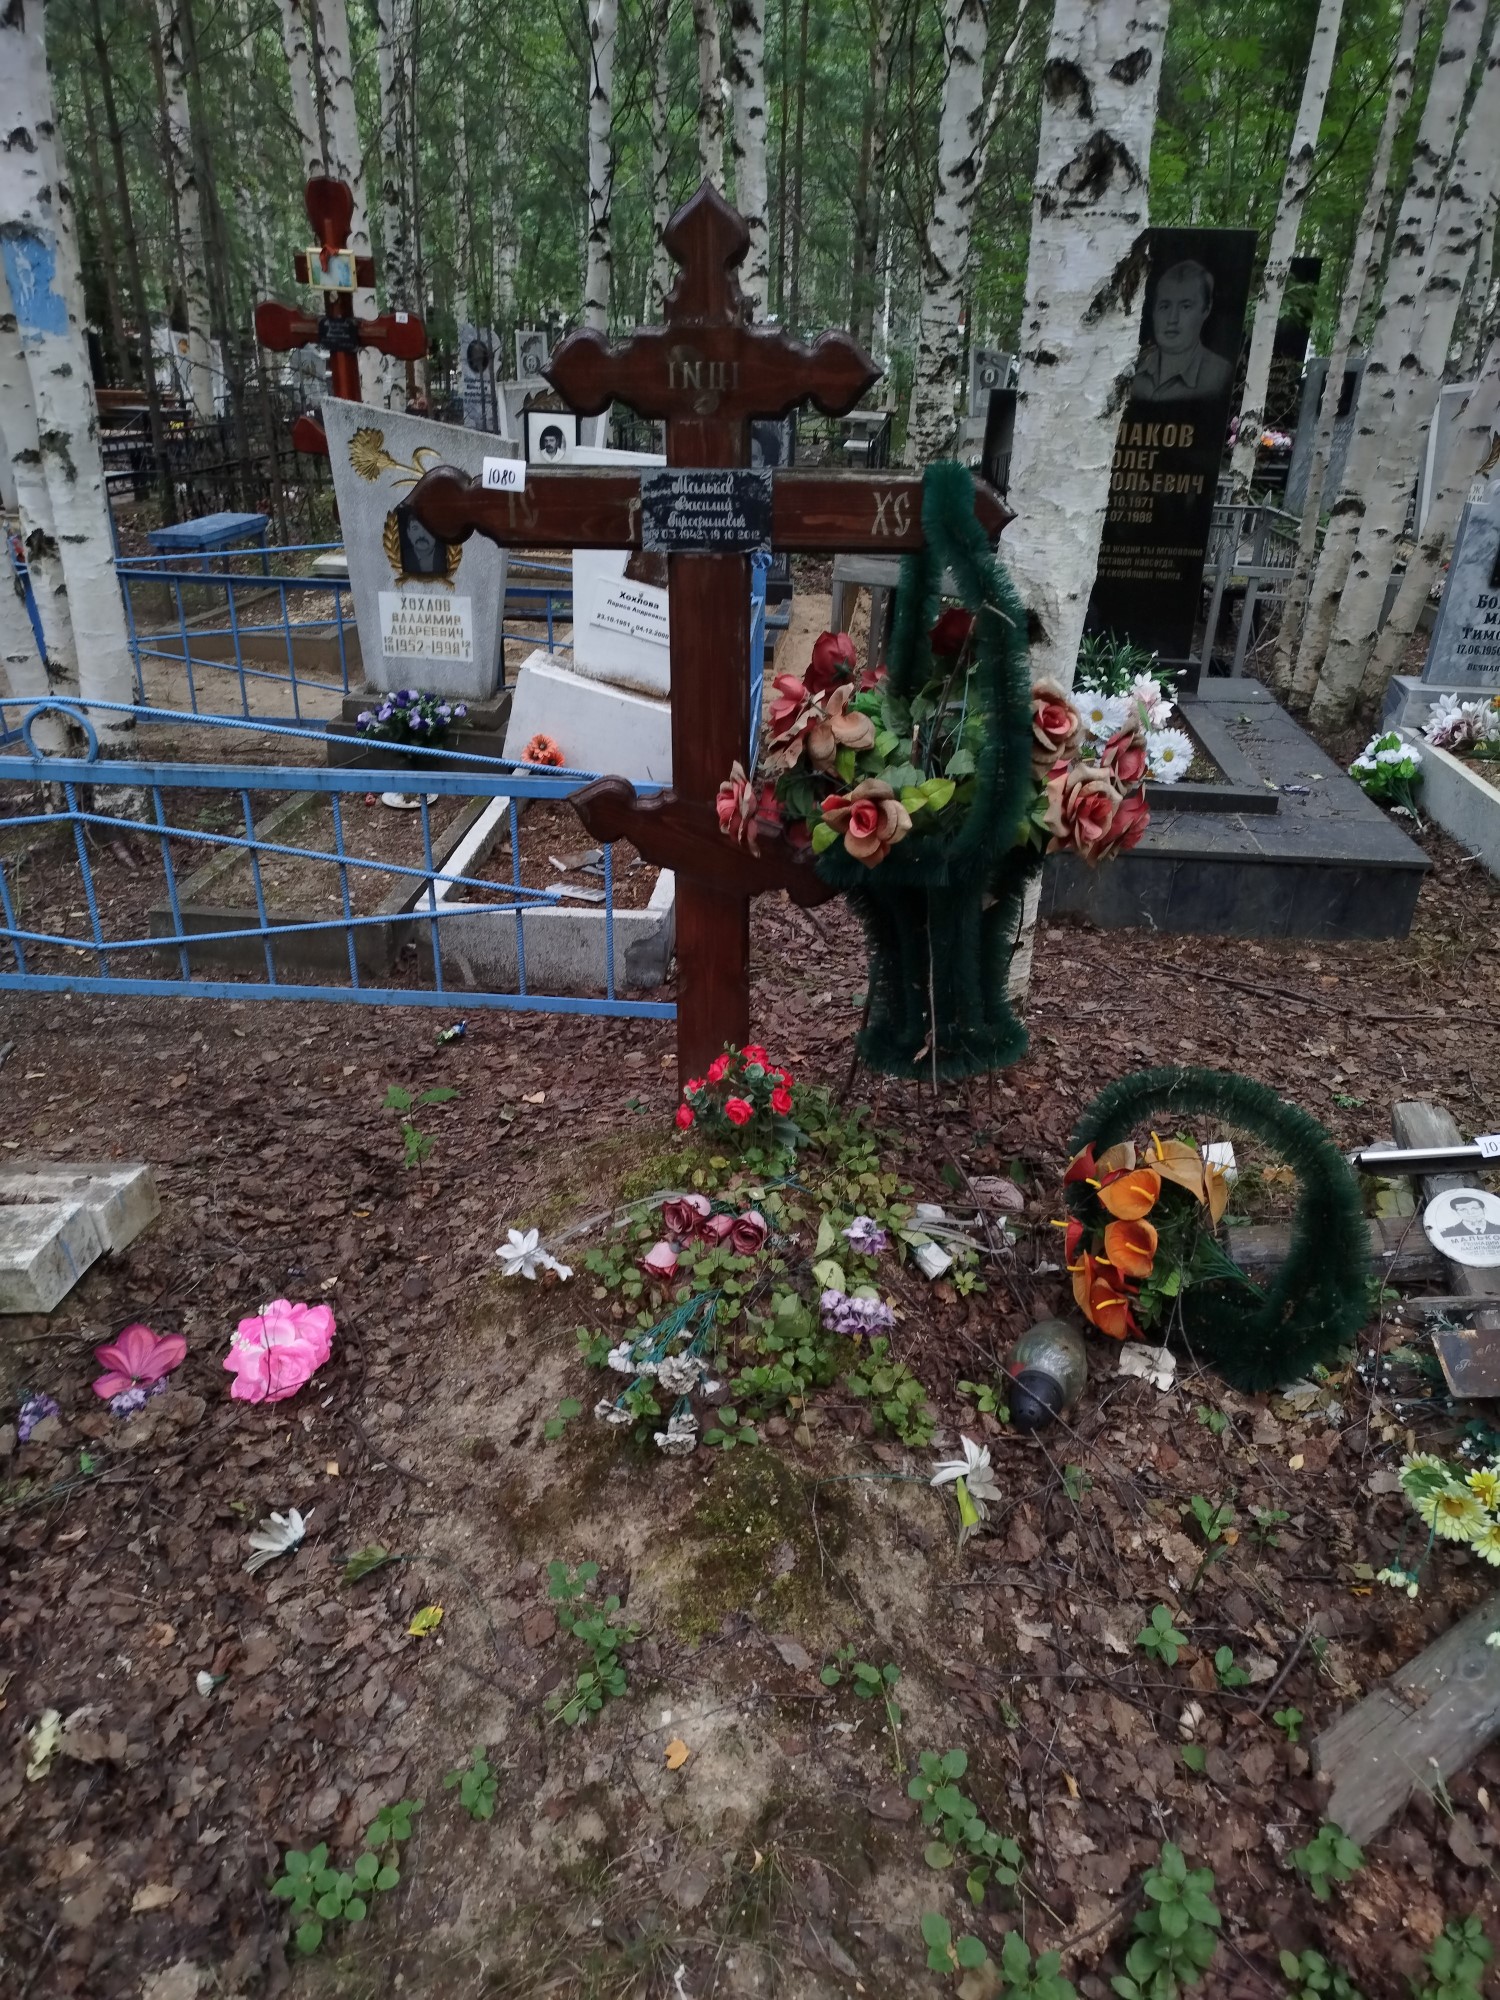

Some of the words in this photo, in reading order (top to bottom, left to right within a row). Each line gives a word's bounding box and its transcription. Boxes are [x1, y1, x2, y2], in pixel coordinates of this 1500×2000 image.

[1112, 449, 1160, 470] ОЛЕГ
[487, 467, 516, 486] 1080
[671, 473, 735, 495] Мальков
[401, 597, 451, 612] ХОХЛОВ
[391, 612, 462, 626] ВЛАДИМИР
[391, 625, 464, 639] АНДРЕЕВИЧ
